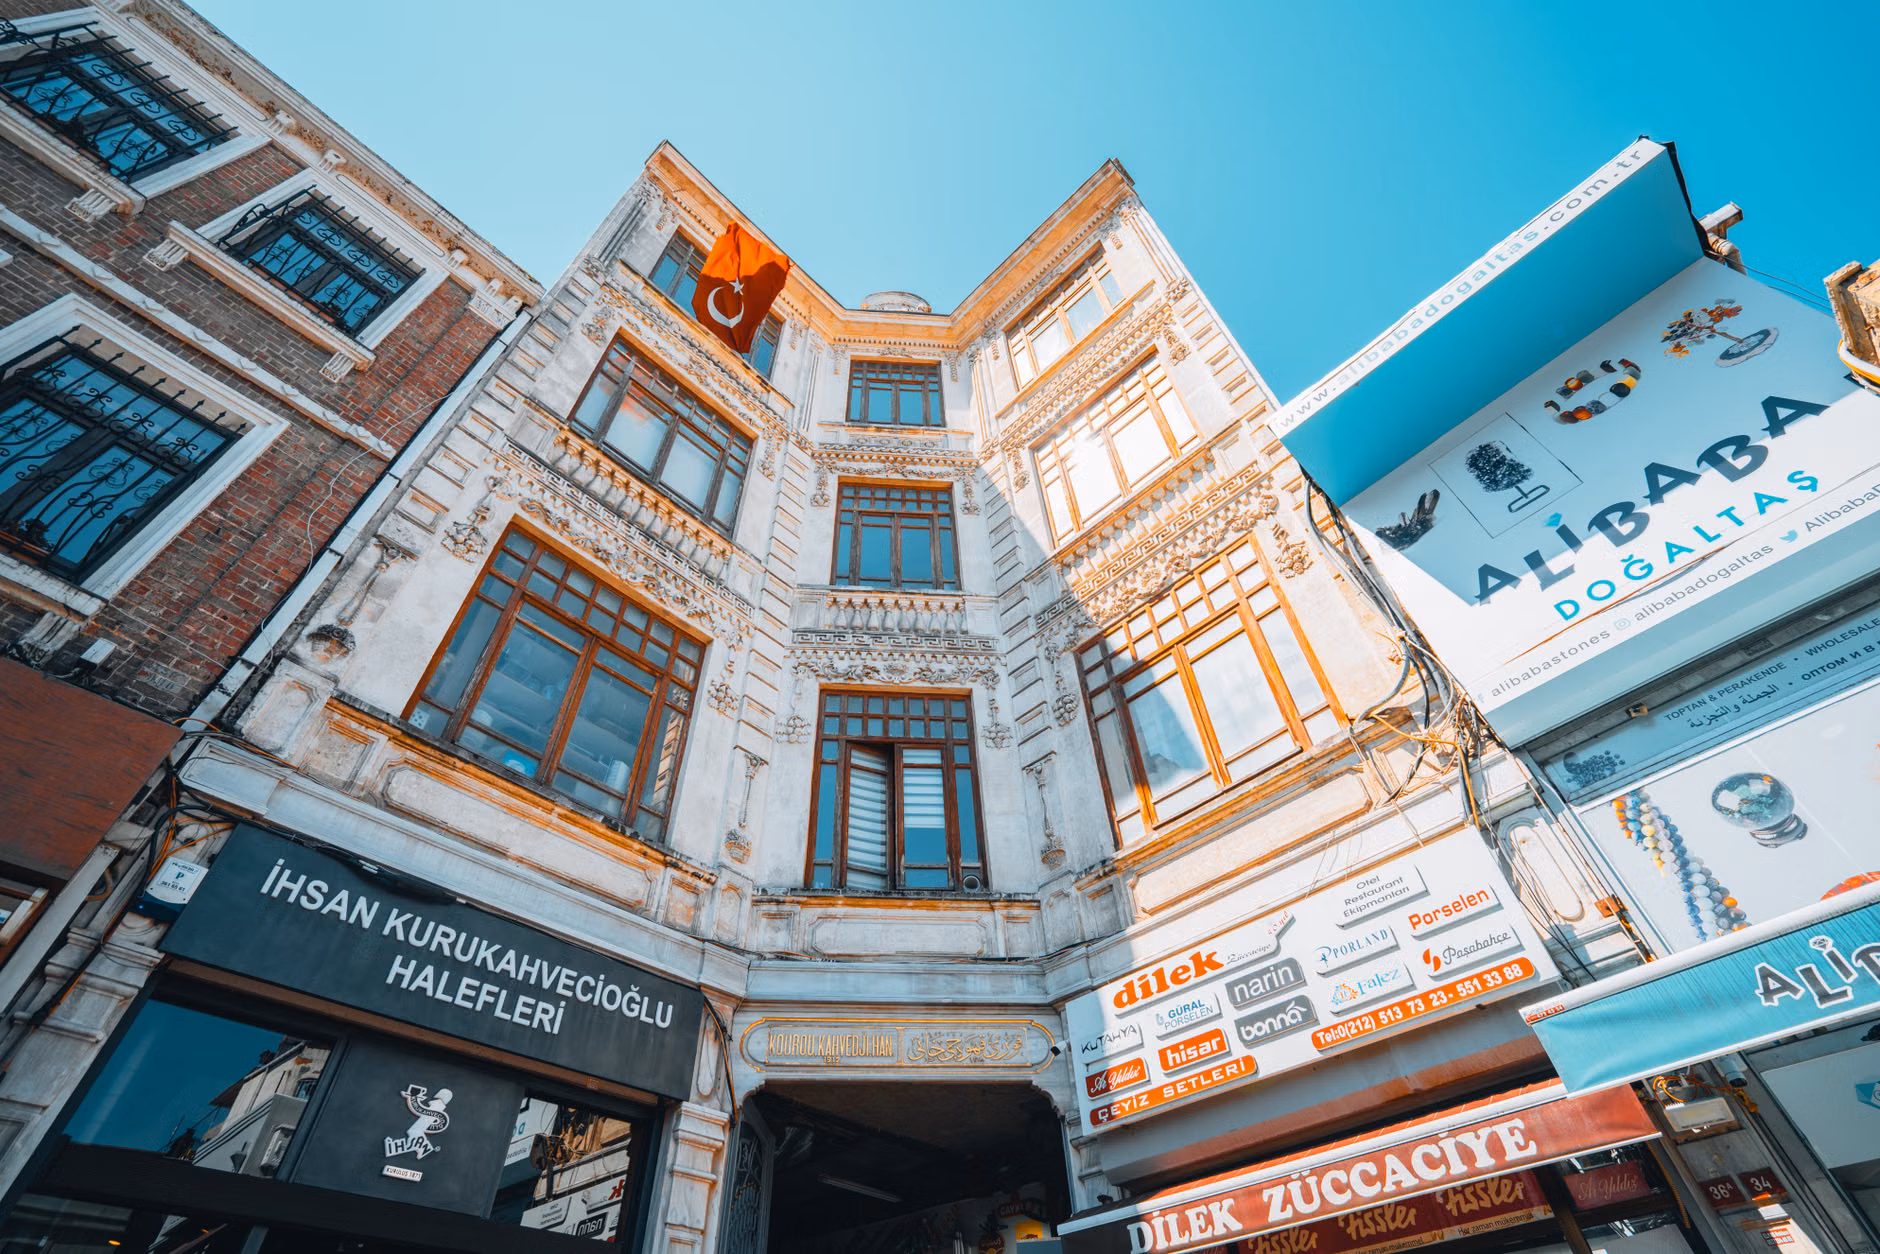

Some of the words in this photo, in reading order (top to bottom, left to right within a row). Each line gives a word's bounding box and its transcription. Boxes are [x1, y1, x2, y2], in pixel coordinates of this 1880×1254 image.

[1279, 149, 1642, 430] www.alibabadogaltas.com.tr
[1475, 396, 1831, 605] ALİBABA
[1553, 470, 1819, 620] DOĞALTAŞ
[1634, 544, 1774, 621] alibabadogaltas
[1491, 629, 1611, 697] alibabastones
[1664, 699, 1707, 721] TOPTAN
[1708, 694, 1719, 703] &
[1717, 662, 1787, 697] PERAKENDE
[1805, 617, 1880, 657] WHOLESALE
[1343, 886, 1410, 918] Ekipmanları
[1344, 877, 1404, 906] Restaurant
[1356, 875, 1381, 890] Otel
[1408, 890, 1490, 930] Porselen
[260, 858, 380, 929] İHSAN
[382, 908, 673, 1029] KURUKAHVECİOĞLU
[1332, 928, 1389, 960] PORLAND
[1442, 932, 1512, 965] Paşabahçe
[385, 955, 566, 1035] HALEFLERİ
[1113, 951, 1224, 1009] dilek
[1168, 999, 1205, 1018] GÜRAL
[1233, 966, 1295, 1002] narin
[1378, 1006, 1403, 1025] 513
[1406, 998, 1425, 1014] 73
[1456, 977, 1482, 997] 551
[1483, 970, 1502, 987] 33
[1503, 963, 1523, 980] 88
[1165, 1005, 1214, 1030] PORSELEN
[1166, 1037, 1221, 1066] hisar
[1098, 1094, 1150, 1123] ÇEYİZ
[1163, 1057, 1246, 1098] SETLERİ
[1126, 1198, 1243, 1254] DİLEK
[1263, 1118, 1537, 1222] ZÜCCACİYE
[1750, 1176, 1772, 1192] 34
